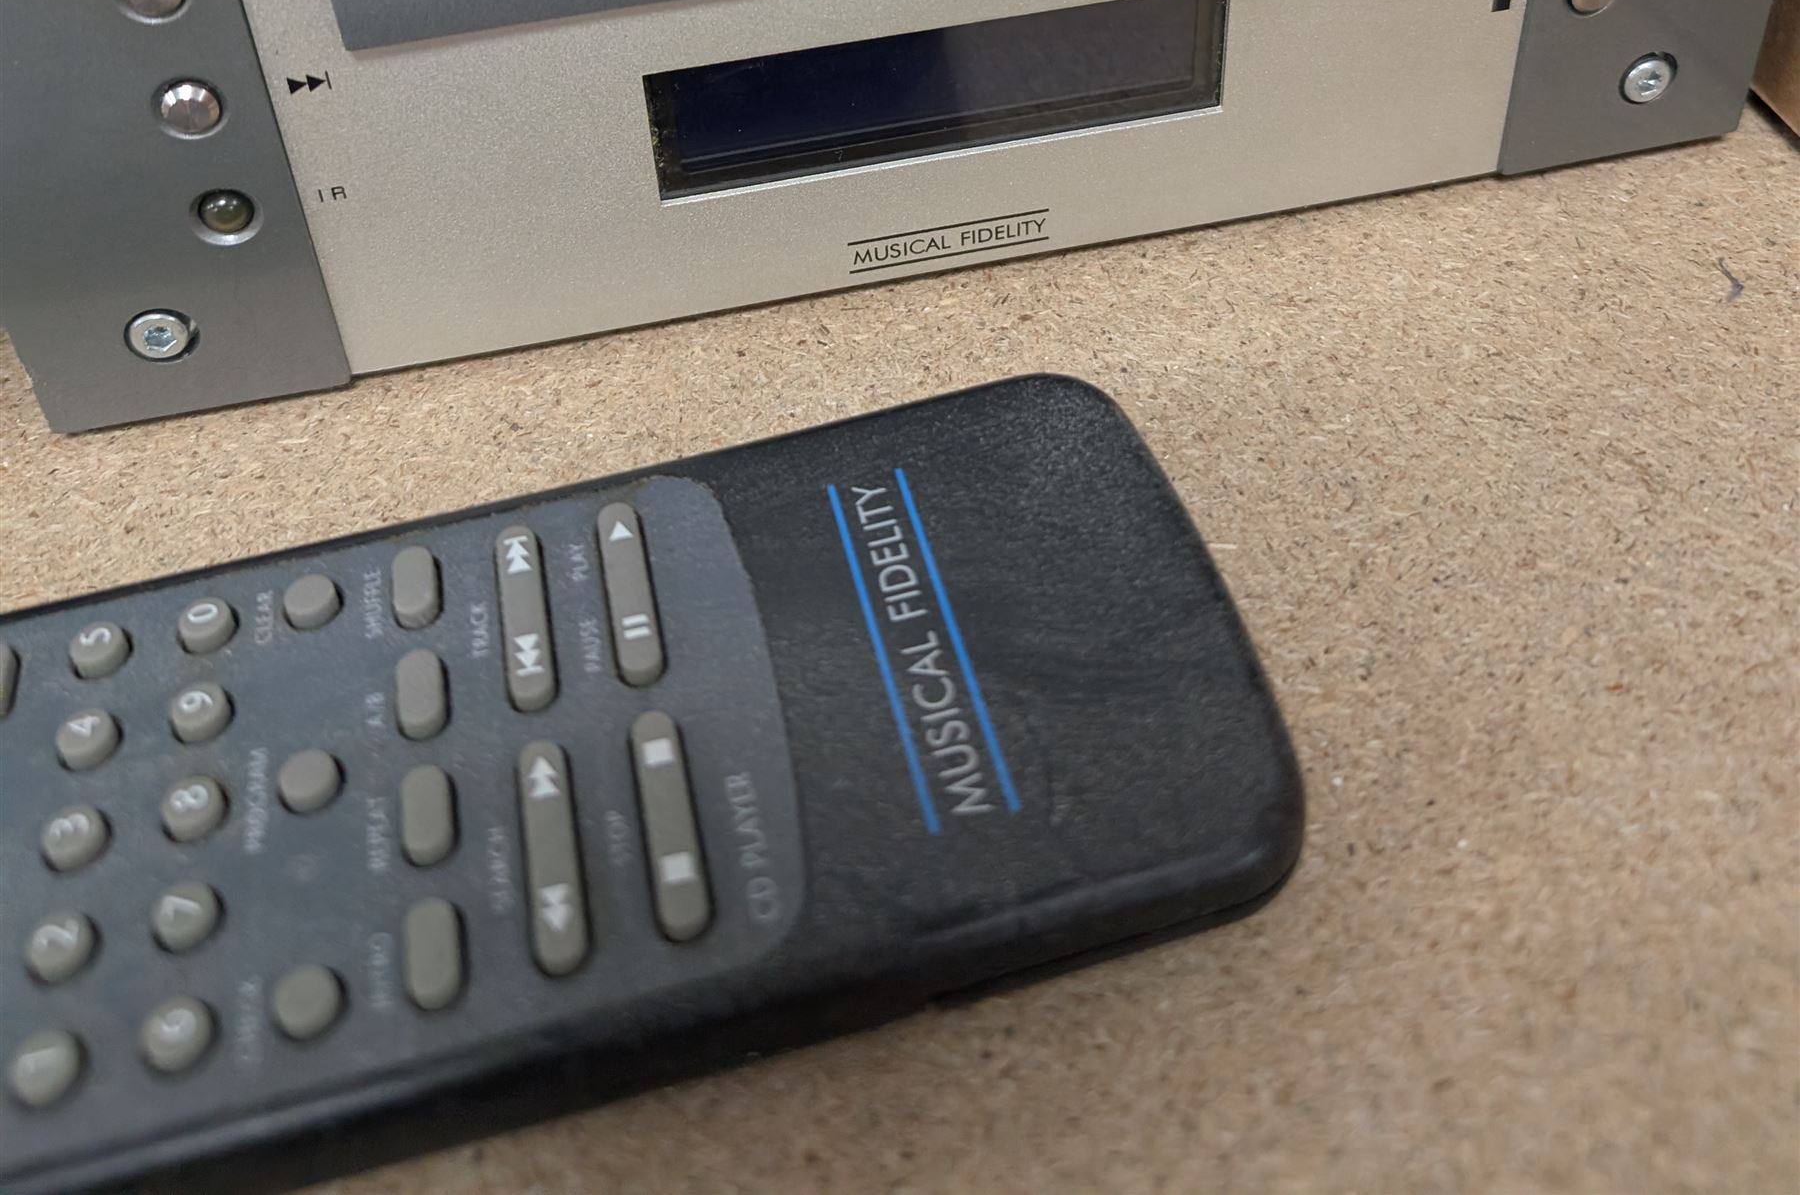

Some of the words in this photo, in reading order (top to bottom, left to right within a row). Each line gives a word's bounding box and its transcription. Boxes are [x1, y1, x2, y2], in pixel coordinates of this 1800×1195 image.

[853, 235, 951, 266] MUSICAL
[960, 217, 1046, 247] FIDELITY
[850, 485, 928, 623] FIDELITY
[254, 590, 274, 647] CLEAR
[363, 569, 384, 640] SHUFFLE
[79, 626, 111, 646] 5
[177, 690, 214, 713] 9
[901, 630, 998, 815] MUSICAL
[64, 715, 101, 738] 4
[169, 784, 210, 811] 8
[723, 770, 770, 869] PLAYER
[746, 876, 783, 925] CD
